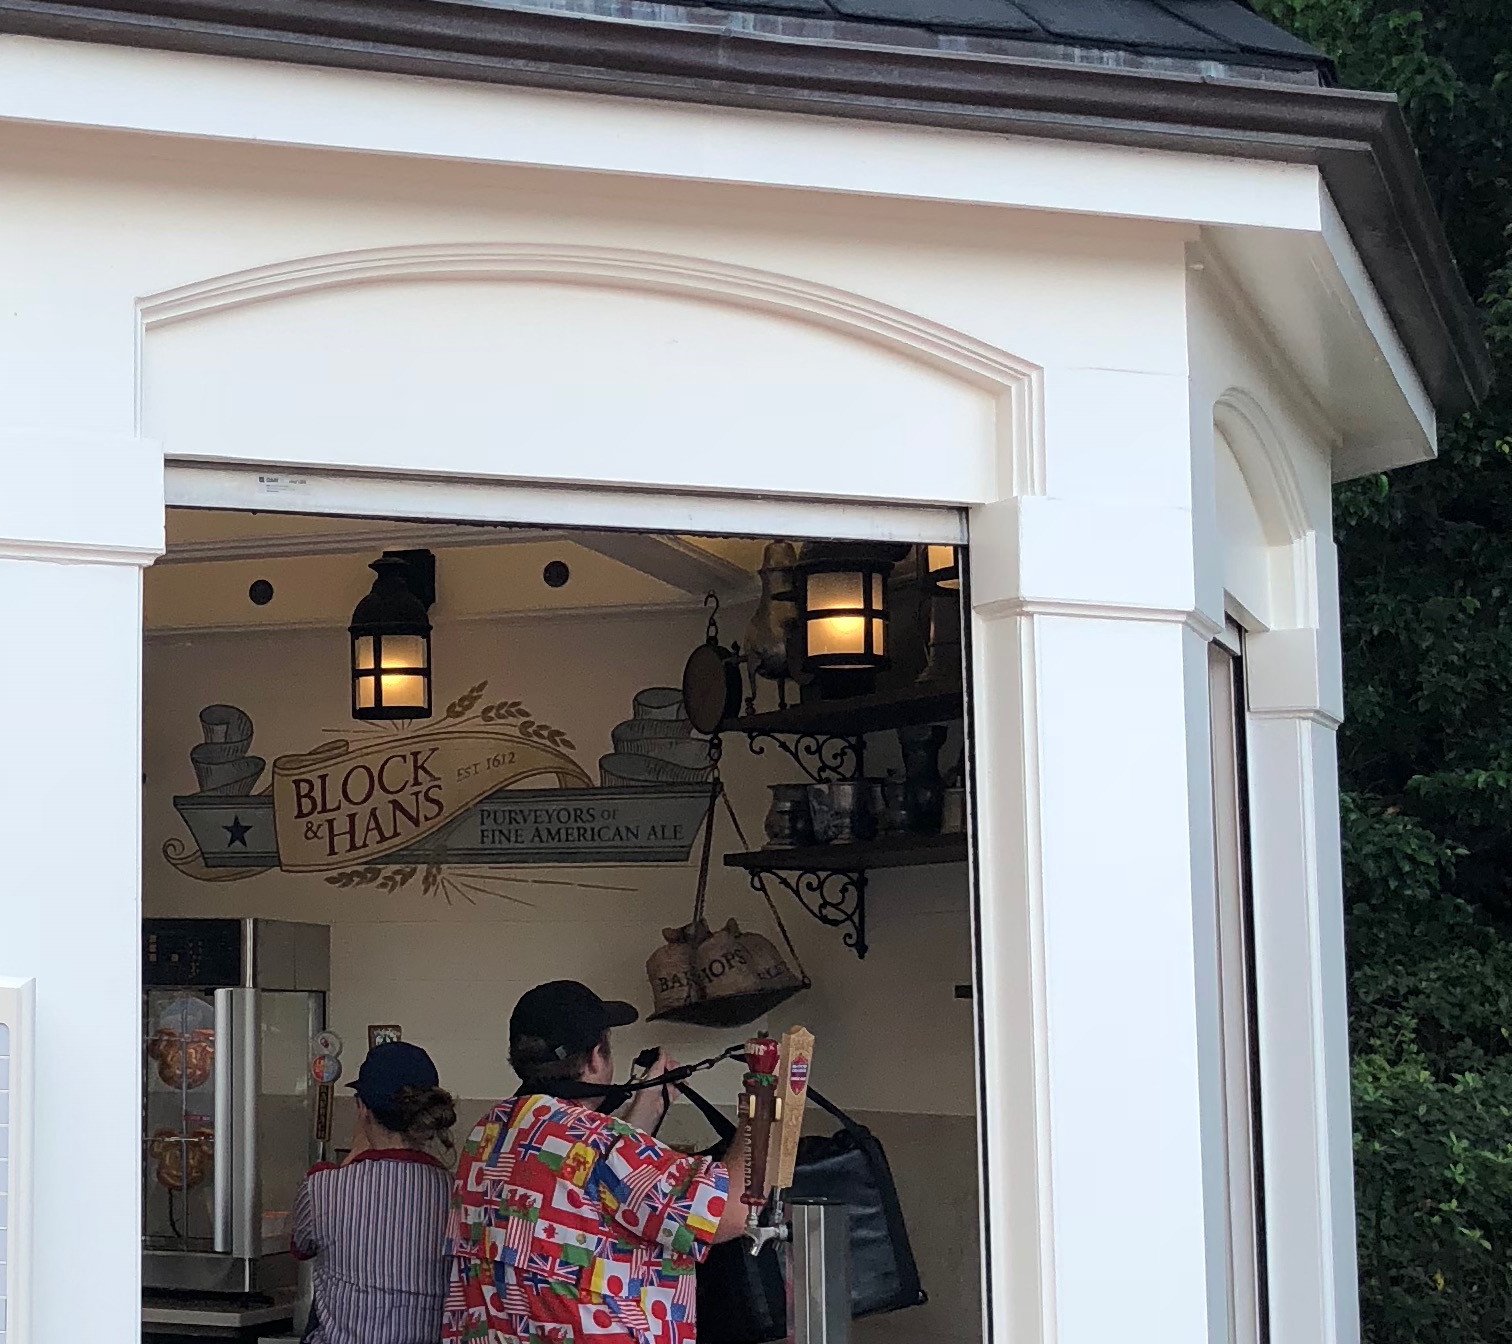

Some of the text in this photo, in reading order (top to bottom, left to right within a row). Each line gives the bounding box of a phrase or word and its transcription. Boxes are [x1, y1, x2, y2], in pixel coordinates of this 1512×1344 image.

[486, 751, 516, 770] 1612
[292, 747, 443, 821] BLOCK
[303, 783, 445, 857] & HANS
[480, 807, 596, 826] PURVEYORS
[480, 824, 684, 845] FINE AMERICAN ALE
